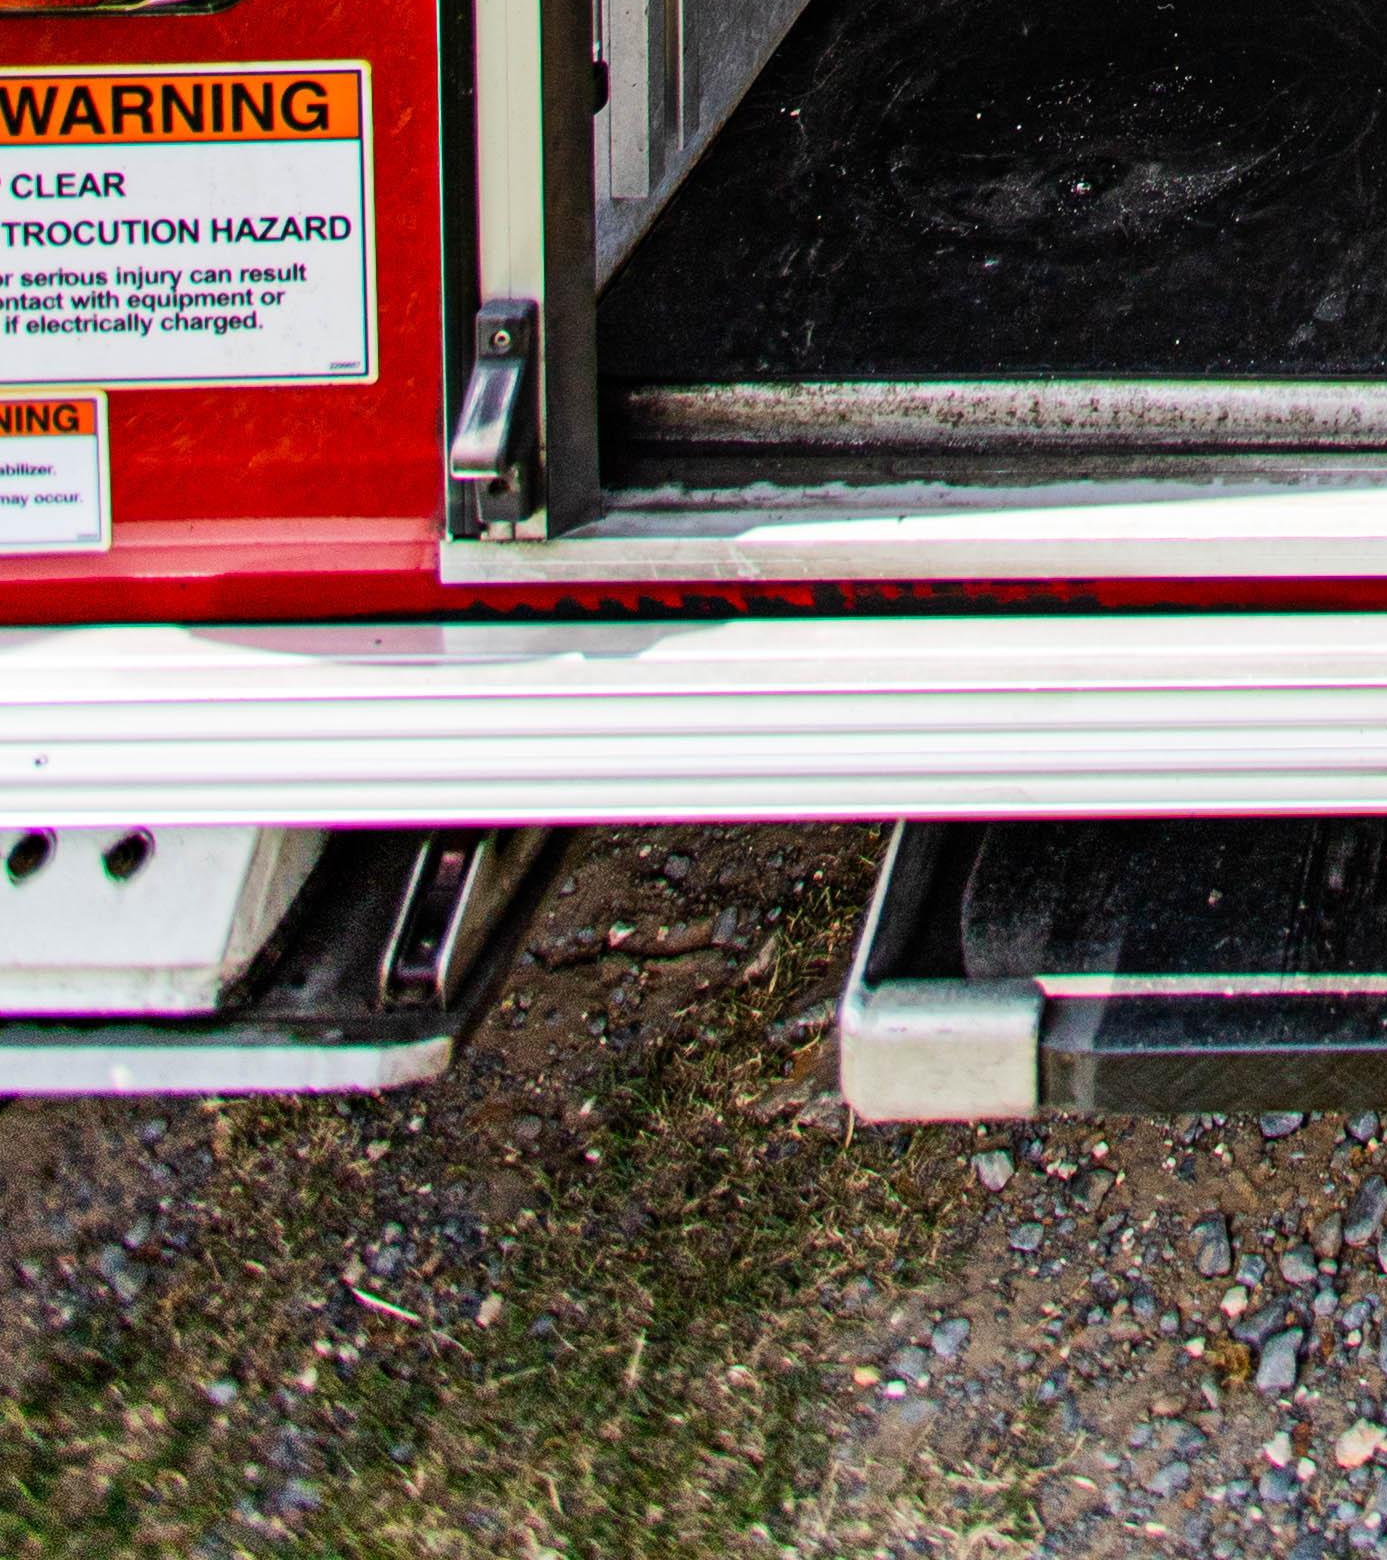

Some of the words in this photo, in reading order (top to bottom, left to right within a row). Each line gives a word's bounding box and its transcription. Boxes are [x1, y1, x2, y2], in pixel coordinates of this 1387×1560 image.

[0, 80, 329, 137] WARNING
[10, 172, 127, 200] CLEAR
[0, 218, 200, 247] TROCUTION
[211, 215, 352, 243] HAZARD
[0, 272, 14, 287] r
[20, 267, 109, 287] serious
[115, 266, 183, 293] injury
[190, 268, 232, 284] can
[240, 263, 307, 283] result
[0, 292, 64, 311] ntact
[71, 290, 120, 310] with
[127, 288, 253, 313] equipment
[260, 290, 286, 306] or
[5, 315, 21, 334] if
[26, 313, 153, 338] electrically
[160, 310, 264, 336] charged.
[34, 492, 83, 504] occur.
